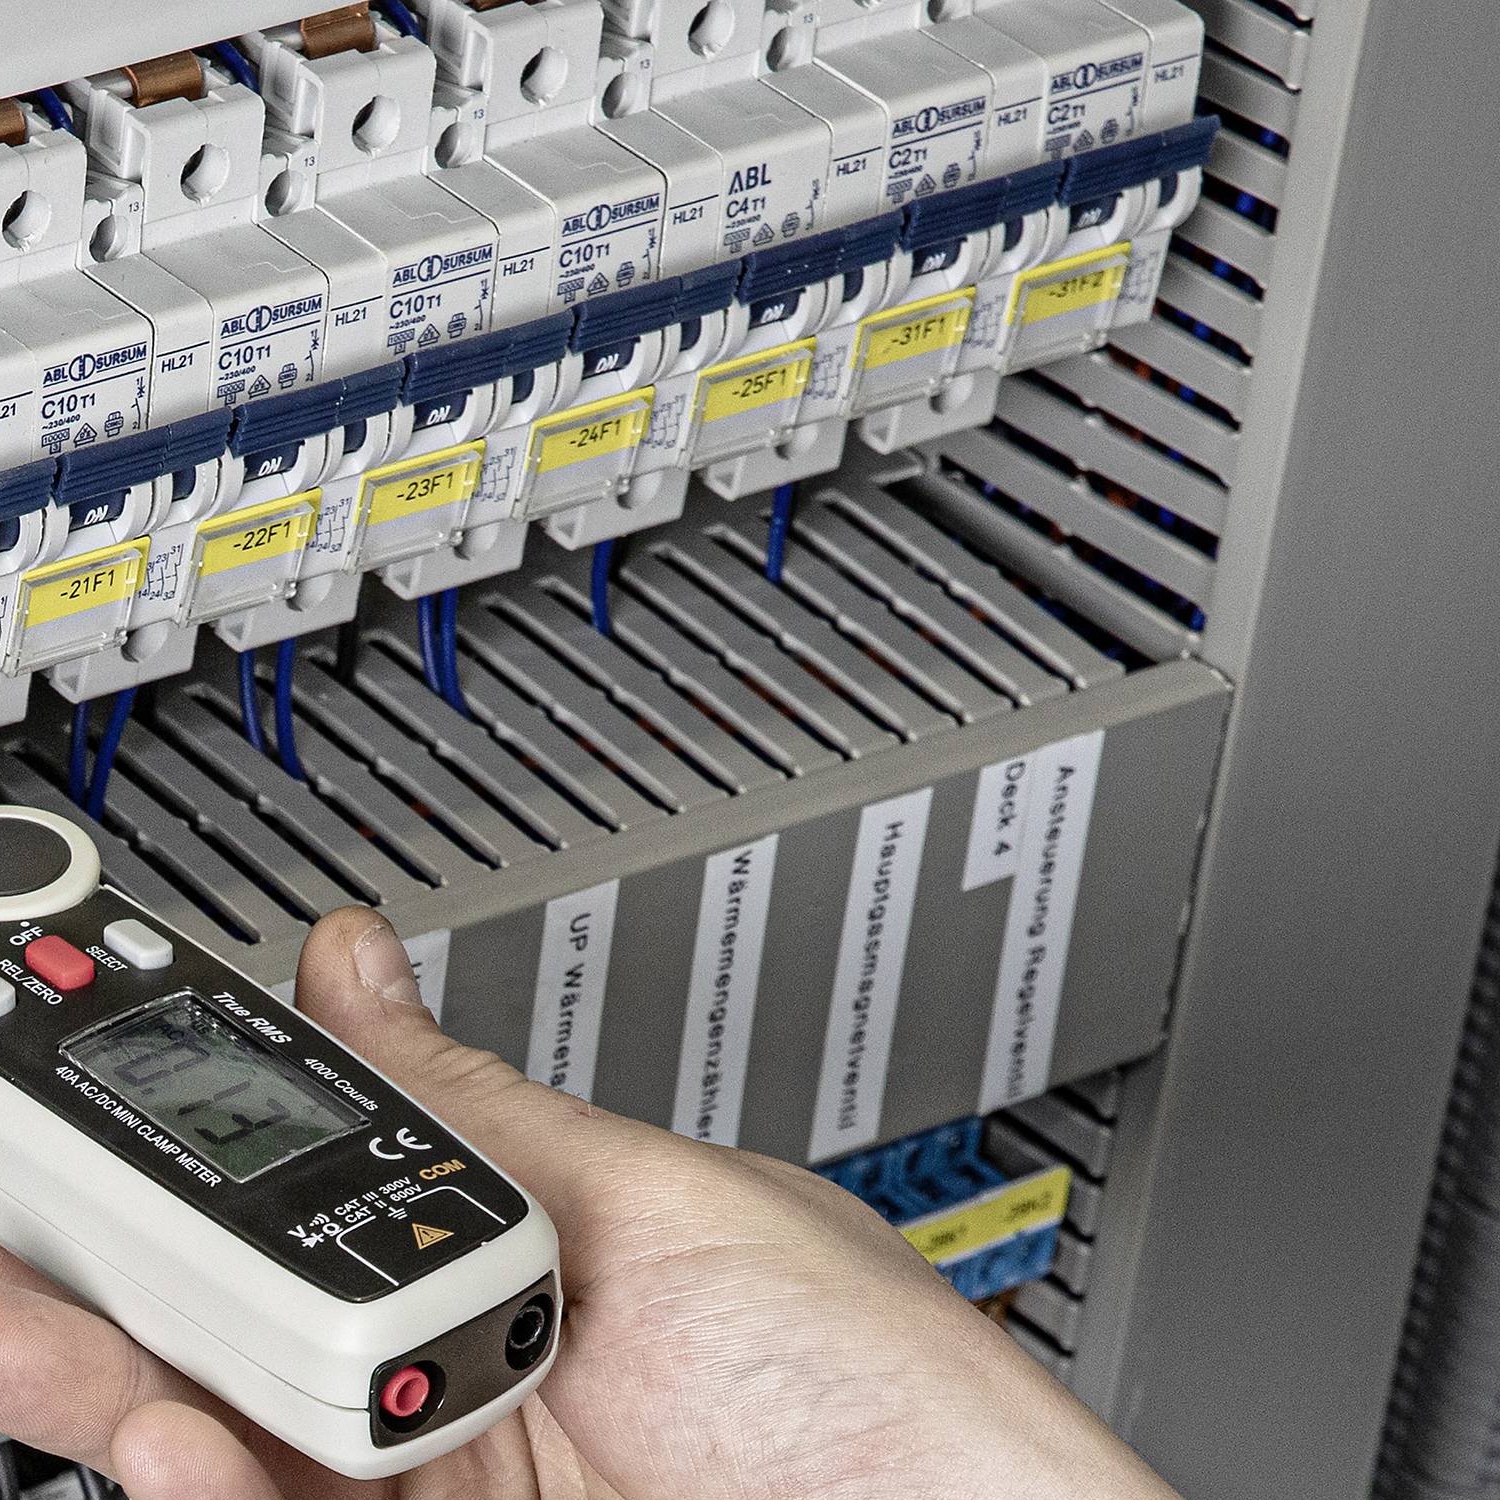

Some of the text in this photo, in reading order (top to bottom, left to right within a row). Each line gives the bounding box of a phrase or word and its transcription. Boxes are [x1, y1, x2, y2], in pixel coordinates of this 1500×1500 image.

[728, 164, 771, 195] ABL
[836, 159, 867, 176] HL21
[562, 196, 659, 233] ABL SURSUM
[727, 199, 749, 218] C4
[393, 248, 492, 284] ABL SURSUM
[503, 260, 534, 276] HL21
[560, 246, 593, 267] C10
[221, 298, 322, 336] ABL SURSUM
[390, 297, 424, 318] C10
[891, 317, 945, 346] -31F1
[43, 345, 146, 386] ABL SURSUM
[161, 354, 194, 373] HL21
[219, 348, 254, 370] C10
[732, 370, 786, 397] -25F1
[42, 396, 78, 418] C10
[570, 419, 621, 447] -24F1
[397, 471, 453, 500] -23F1
[233, 521, 290, 551] -22F1
[60, 571, 115, 599] -21F1
[993, 761, 1025, 857] Deck 4
[9, 926, 43, 946] OFF
[570, 912, 592, 952] UP
[85, 945, 128, 973] SELECT
[212, 991, 292, 1044] True RMS
[304, 1057, 378, 1112] 4000 Counts
[55, 1066, 221, 1188] 40A AC/DC MINI CLAMP METER
[419, 1159, 467, 1181] COM
[334, 1177, 411, 1216] CAT III 300V
[345, 1184, 422, 1223] CAT II 600V
